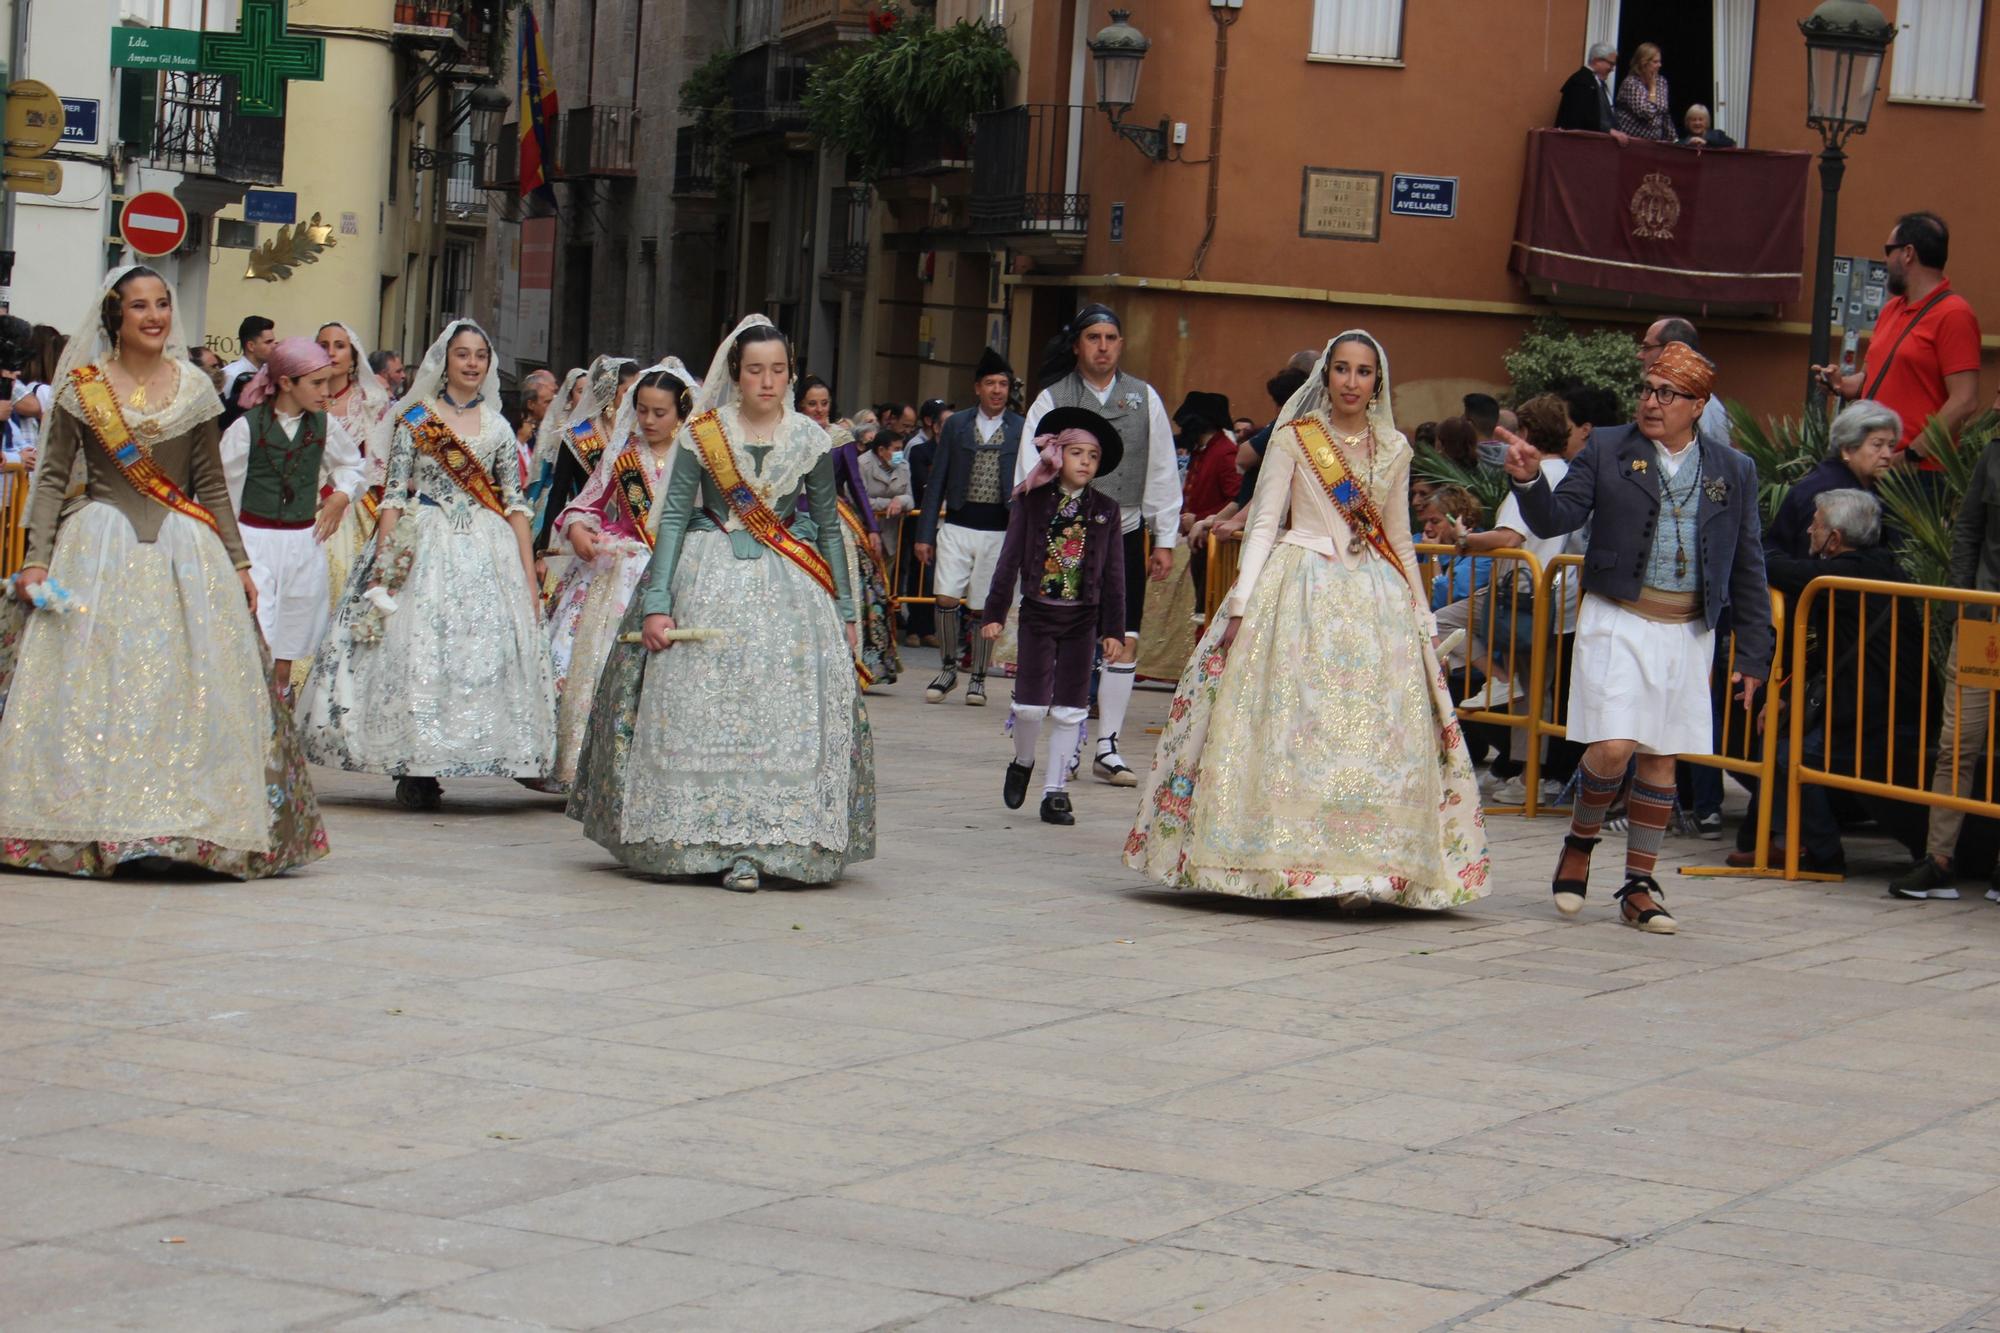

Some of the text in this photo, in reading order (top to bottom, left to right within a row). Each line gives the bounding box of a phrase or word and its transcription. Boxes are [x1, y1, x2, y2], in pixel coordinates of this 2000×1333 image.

[128, 36, 150, 48] Lda.
[128, 53, 158, 64] Amparo
[159, 54, 172, 64] Gil
[1413, 183, 1441, 191] CARRER
[1397, 201, 1449, 212] AVELLANES
